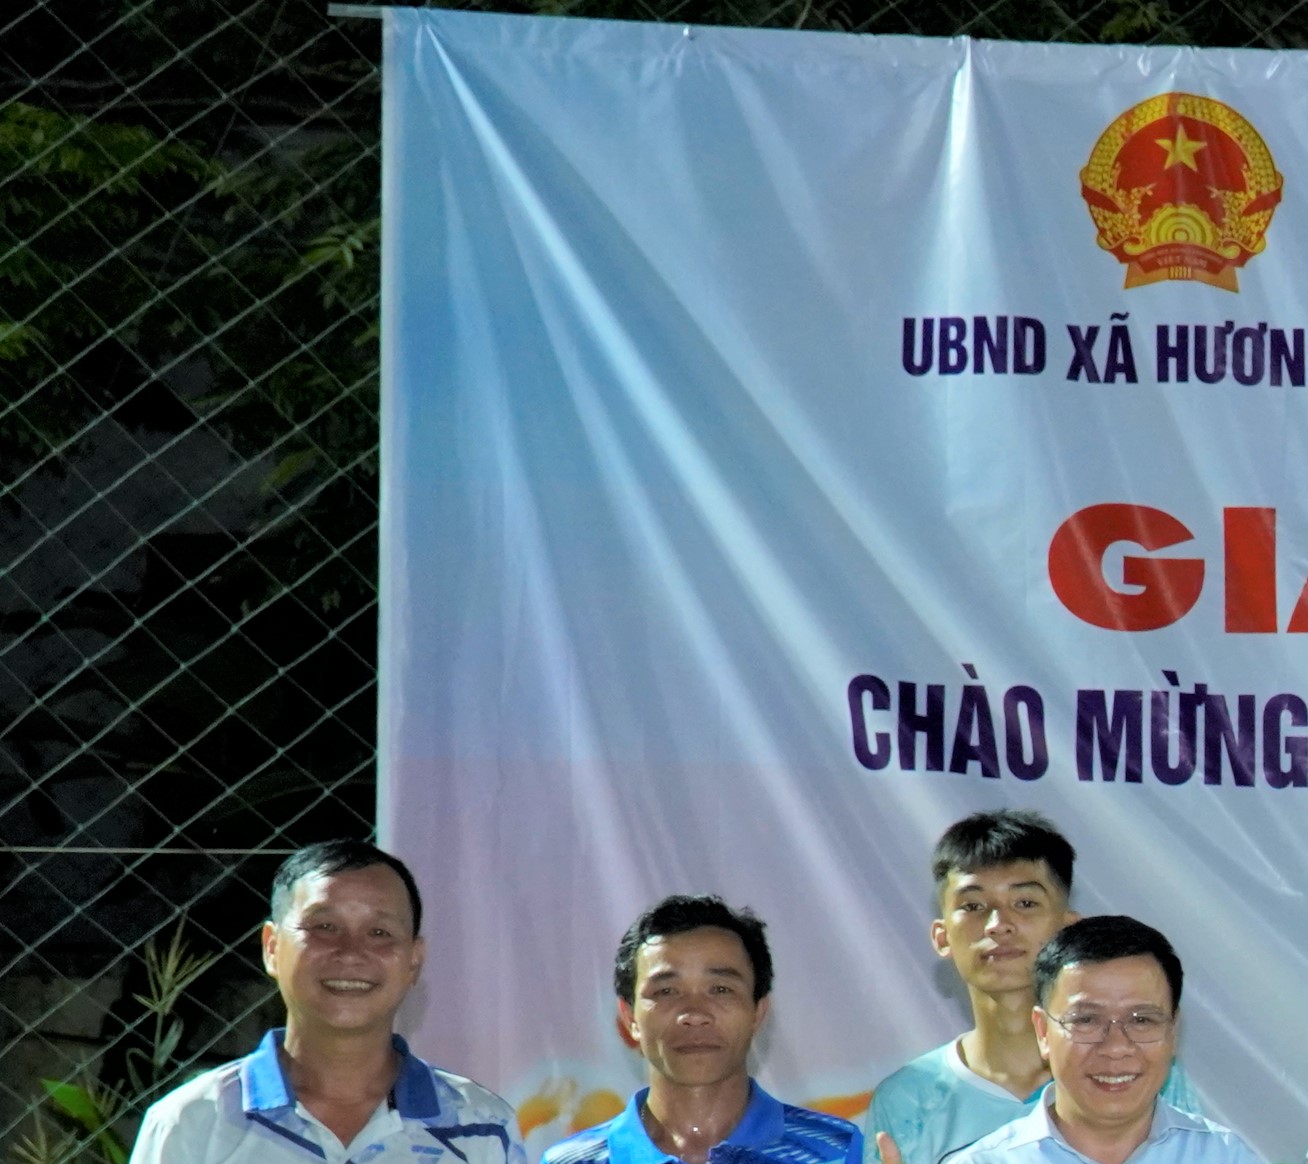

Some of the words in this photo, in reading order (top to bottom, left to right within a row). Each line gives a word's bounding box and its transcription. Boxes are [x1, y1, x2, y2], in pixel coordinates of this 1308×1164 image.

[903, 316, 1047, 377] UBND
[1066, 312, 1138, 384] XÃ
[847, 663, 1050, 781] CHÀO
[1074, 670, 1308, 788] MỪNG
